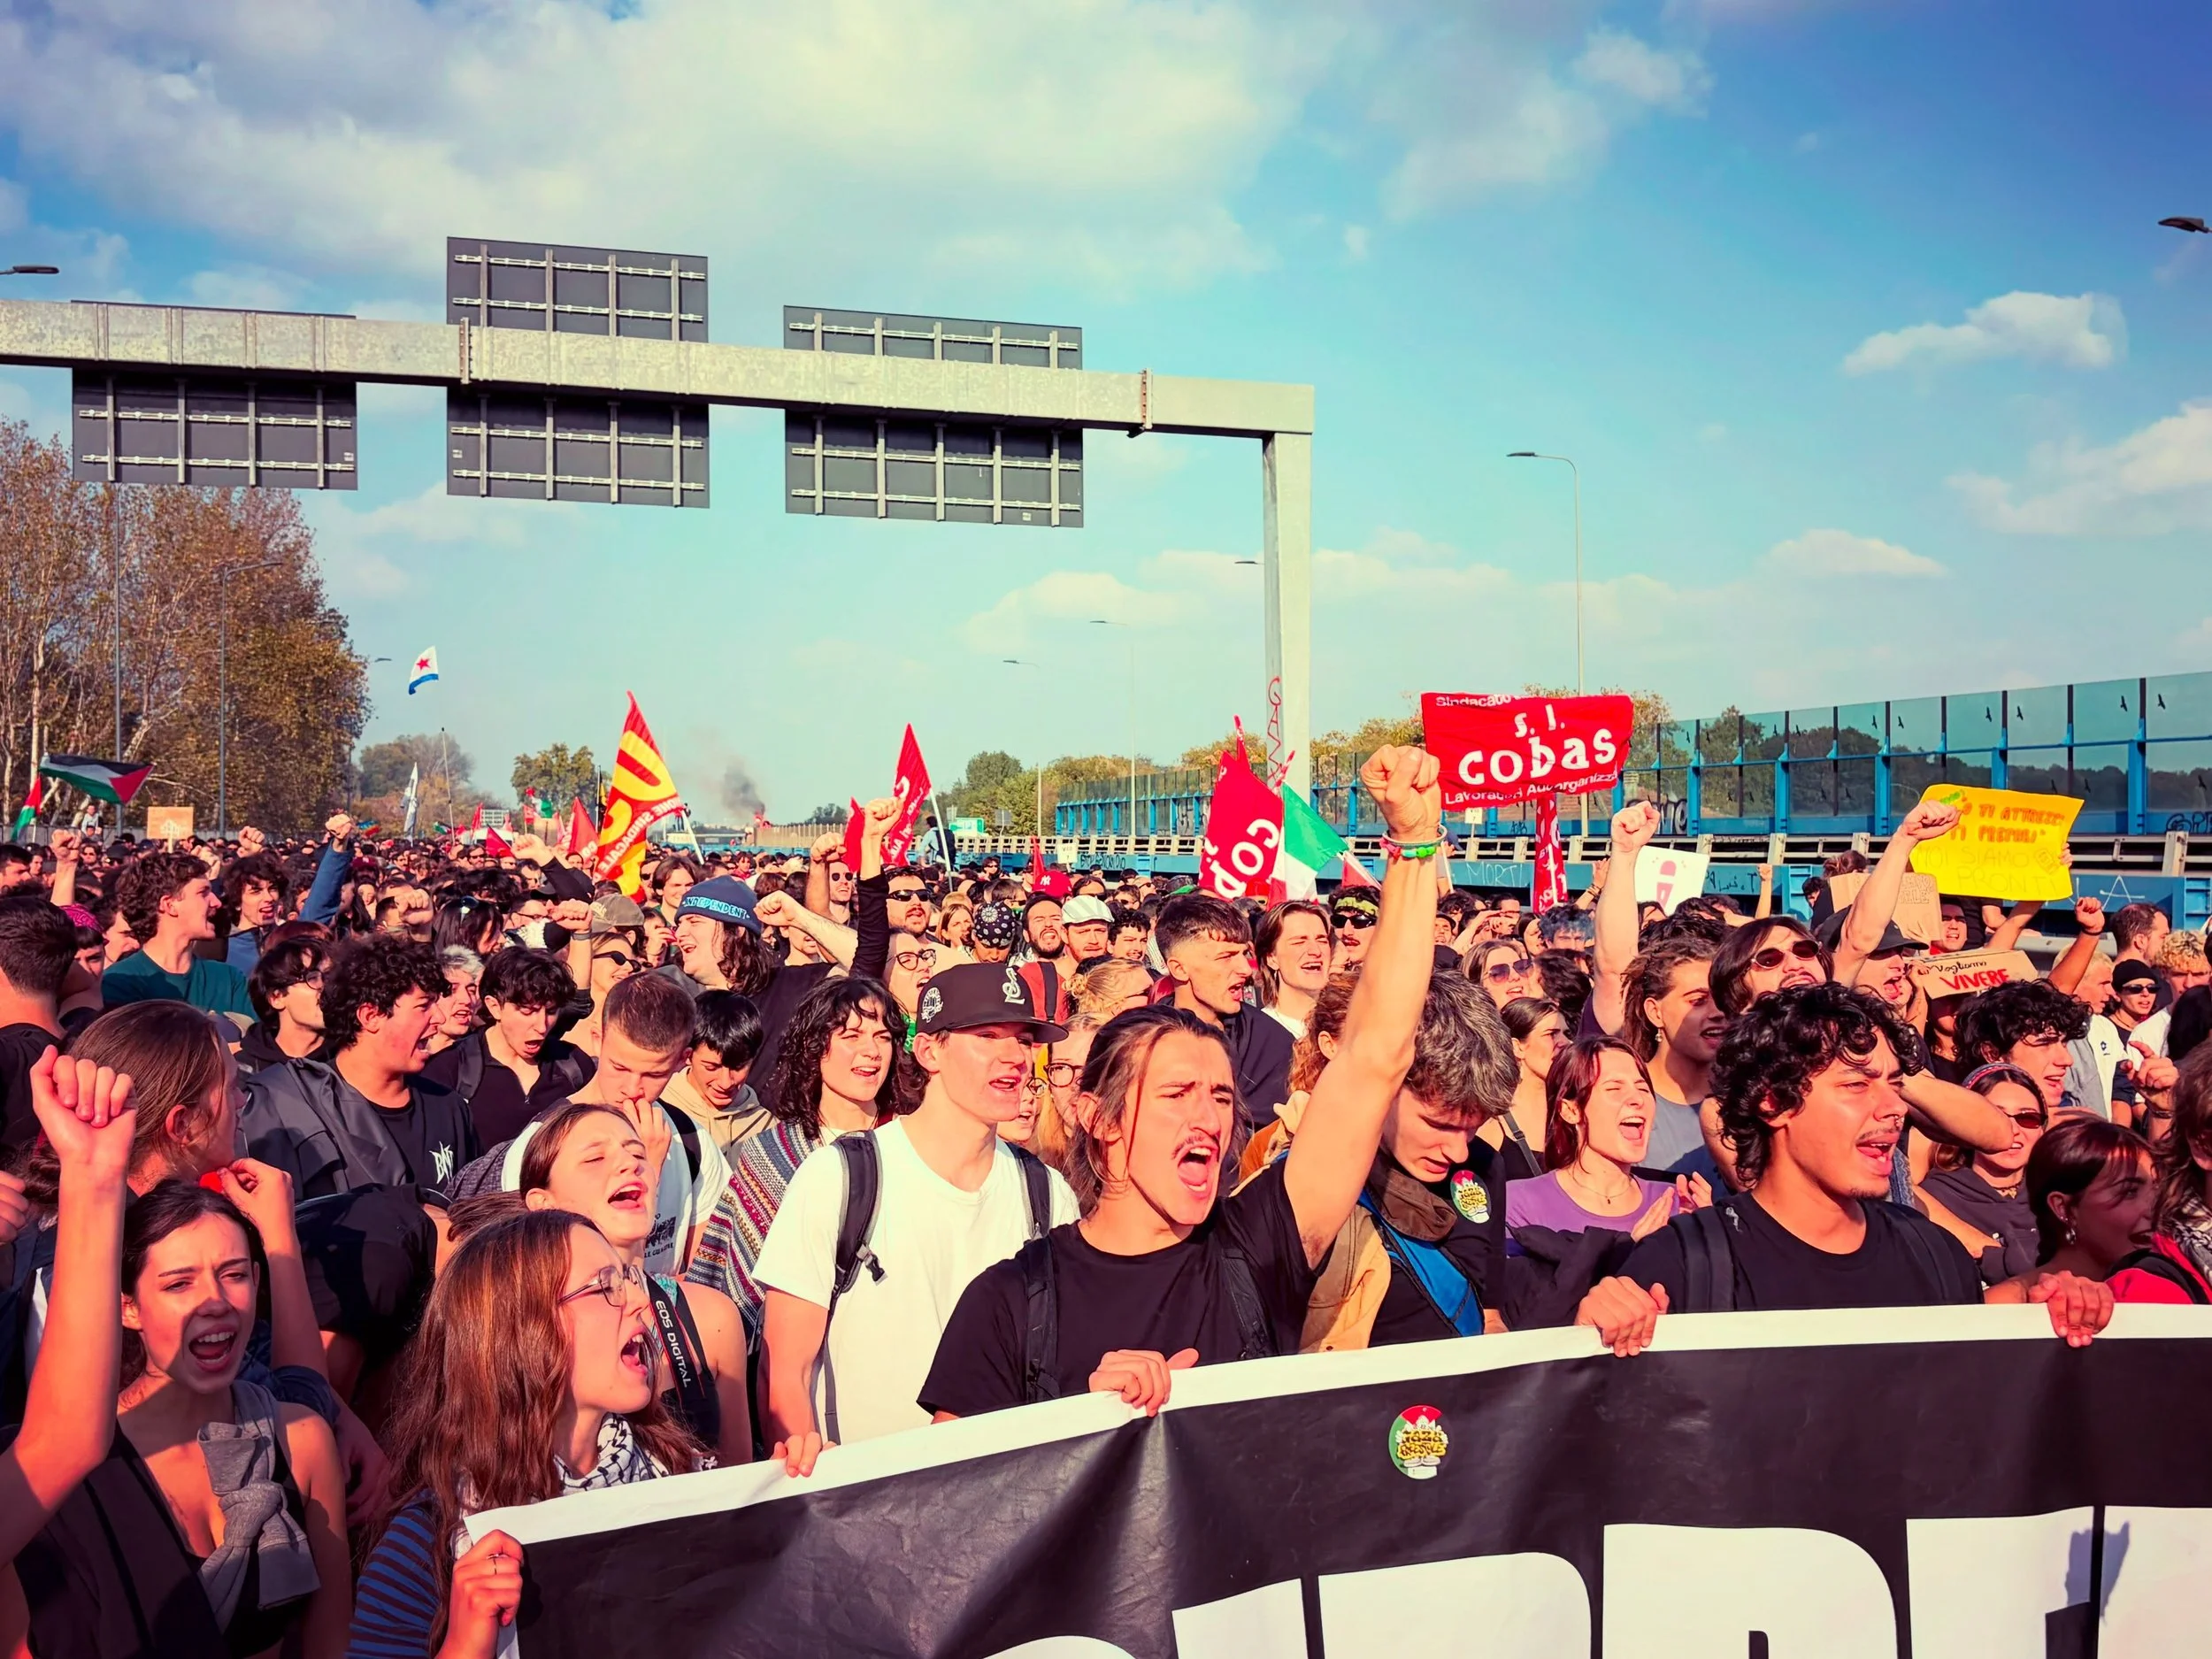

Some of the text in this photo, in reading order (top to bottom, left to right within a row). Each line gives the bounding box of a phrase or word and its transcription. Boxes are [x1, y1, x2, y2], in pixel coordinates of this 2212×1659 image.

[1961, 846, 2030, 867] SIAMO
[1957, 866, 2057, 896] PRONTI
[1939, 969, 2010, 991] VIVERE
[656, 1300, 692, 1388] EOS DIGITAL
